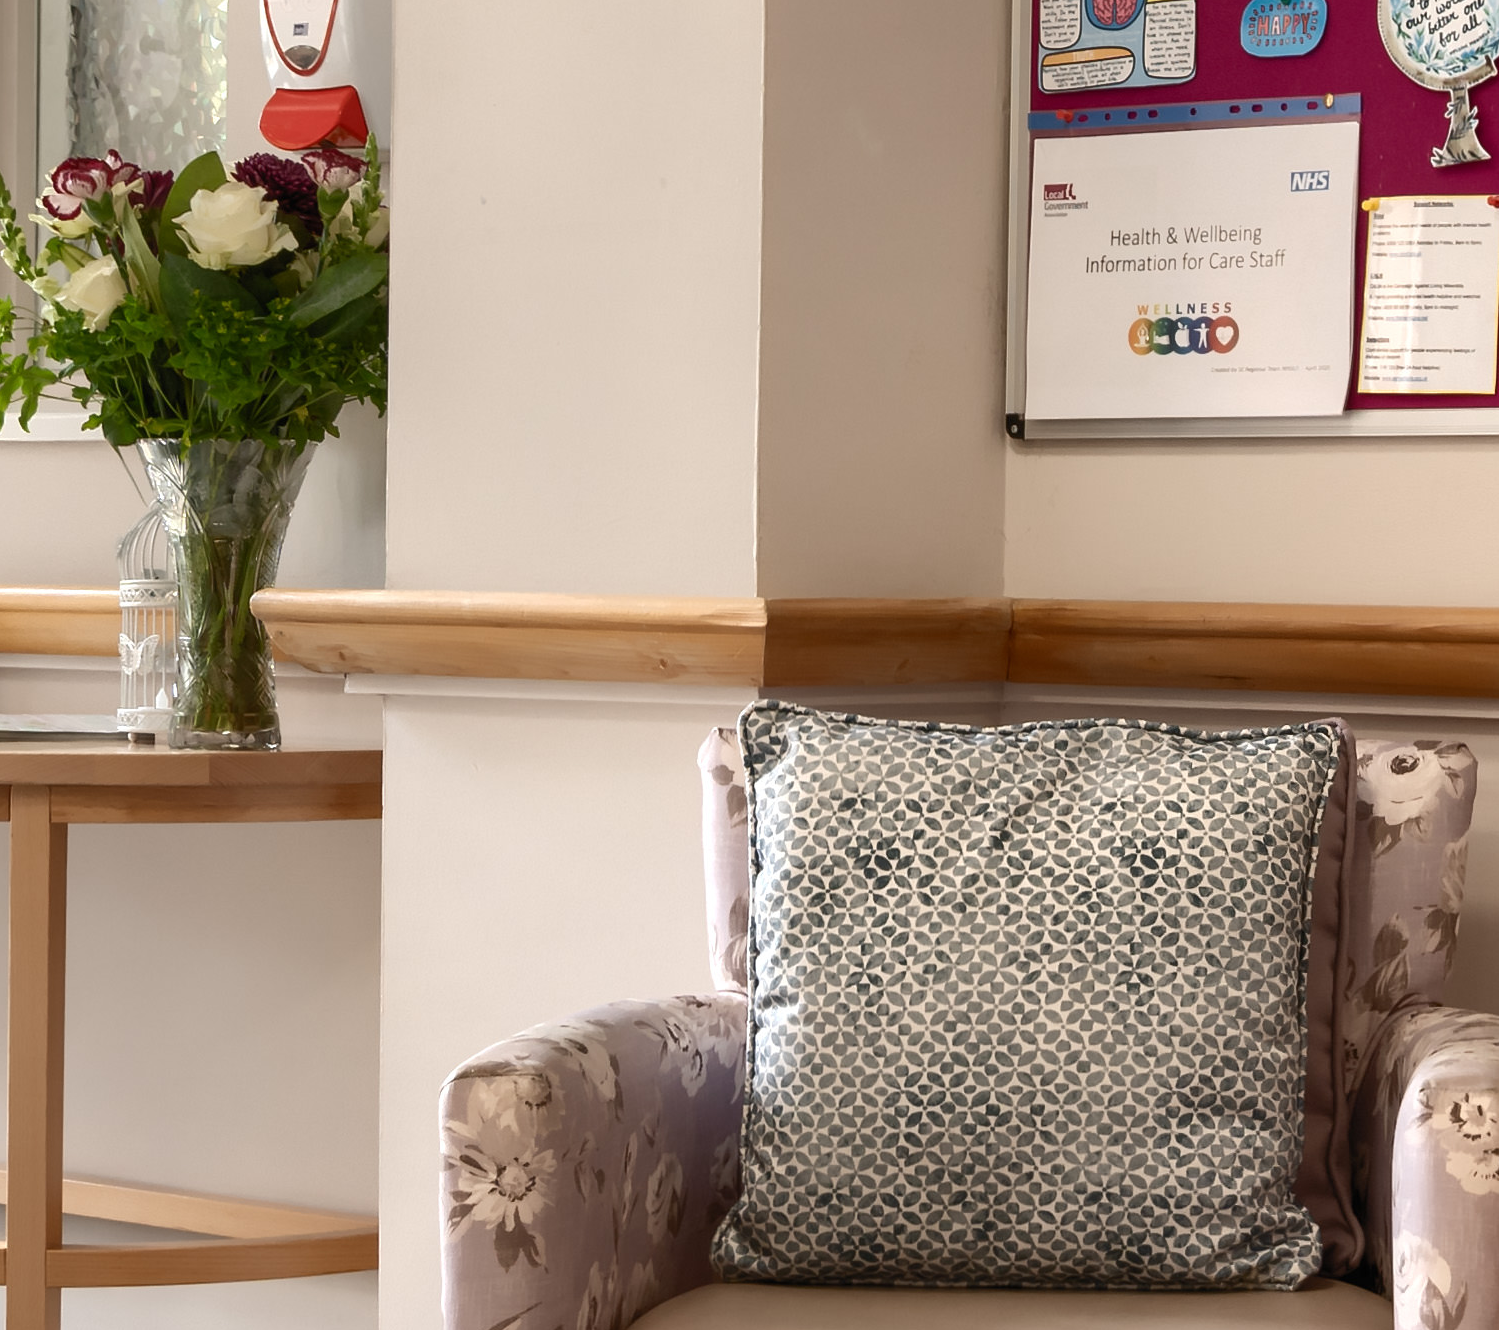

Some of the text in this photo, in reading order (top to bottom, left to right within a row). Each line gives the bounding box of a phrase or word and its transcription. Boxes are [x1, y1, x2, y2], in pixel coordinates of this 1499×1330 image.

[1256, 12, 1309, 36] HAPPY
[1406, 12, 1431, 29] our
[1428, 11, 1459, 34] better
[1439, 31, 1459, 47] for
[1462, 15, 1482, 33] all
[1291, 172, 1328, 190] NHS
[1044, 189, 1065, 199] Local
[1044, 201, 1088, 211] Government
[1110, 225, 1262, 246] Health & Wellbeing
[1086, 249, 1286, 273] Information for Care Staff
[1137, 302, 1232, 315] WELLNESS
